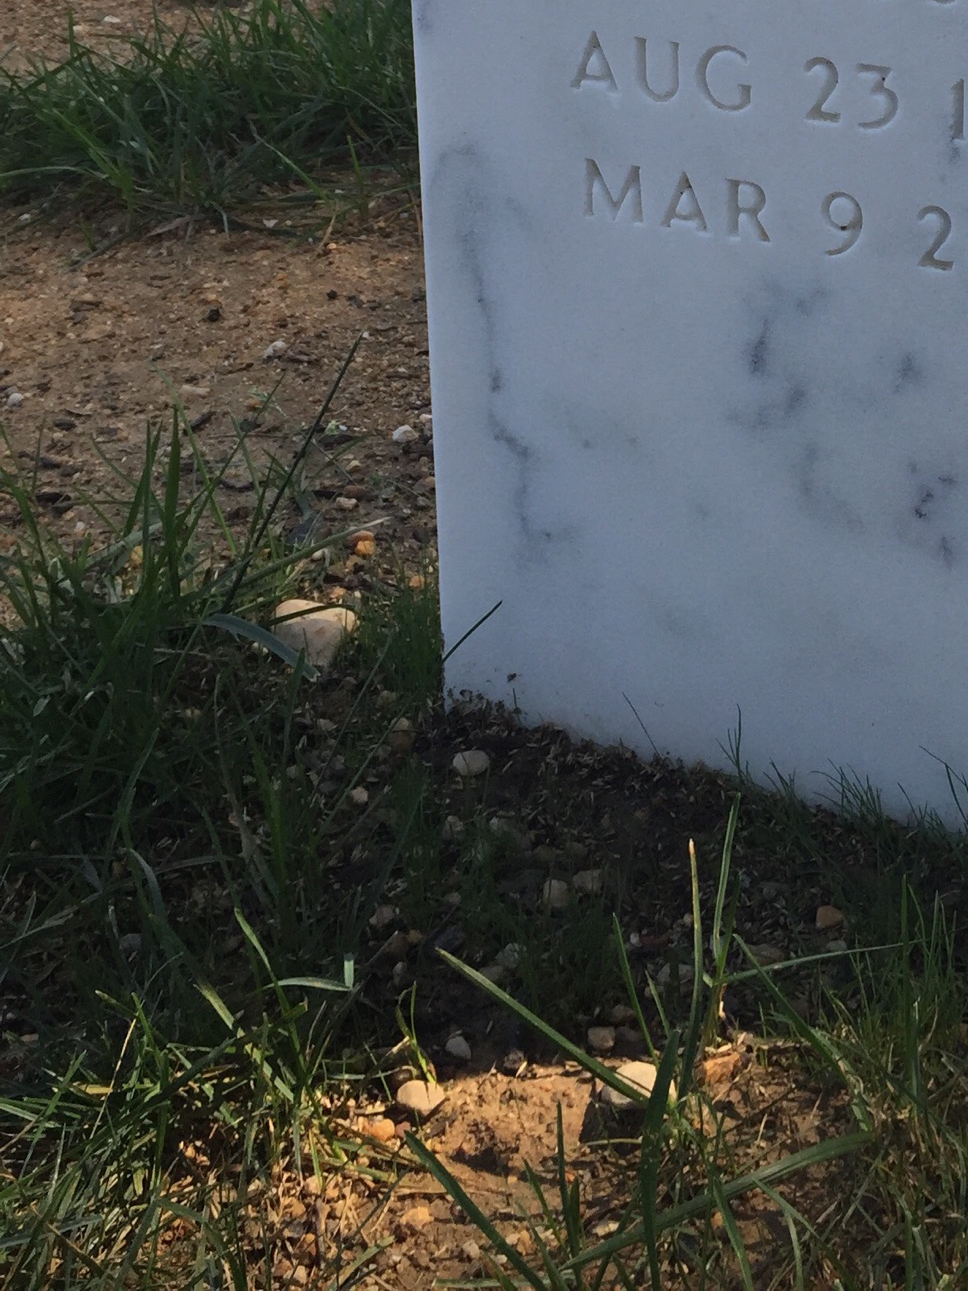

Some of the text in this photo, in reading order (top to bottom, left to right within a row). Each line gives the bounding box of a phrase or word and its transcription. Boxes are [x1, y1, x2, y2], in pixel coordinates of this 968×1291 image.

[569, 29, 753, 113] AUG
[803, 55, 899, 131] 23
[582, 157, 771, 244] MAR
[820, 190, 864, 258] 9
